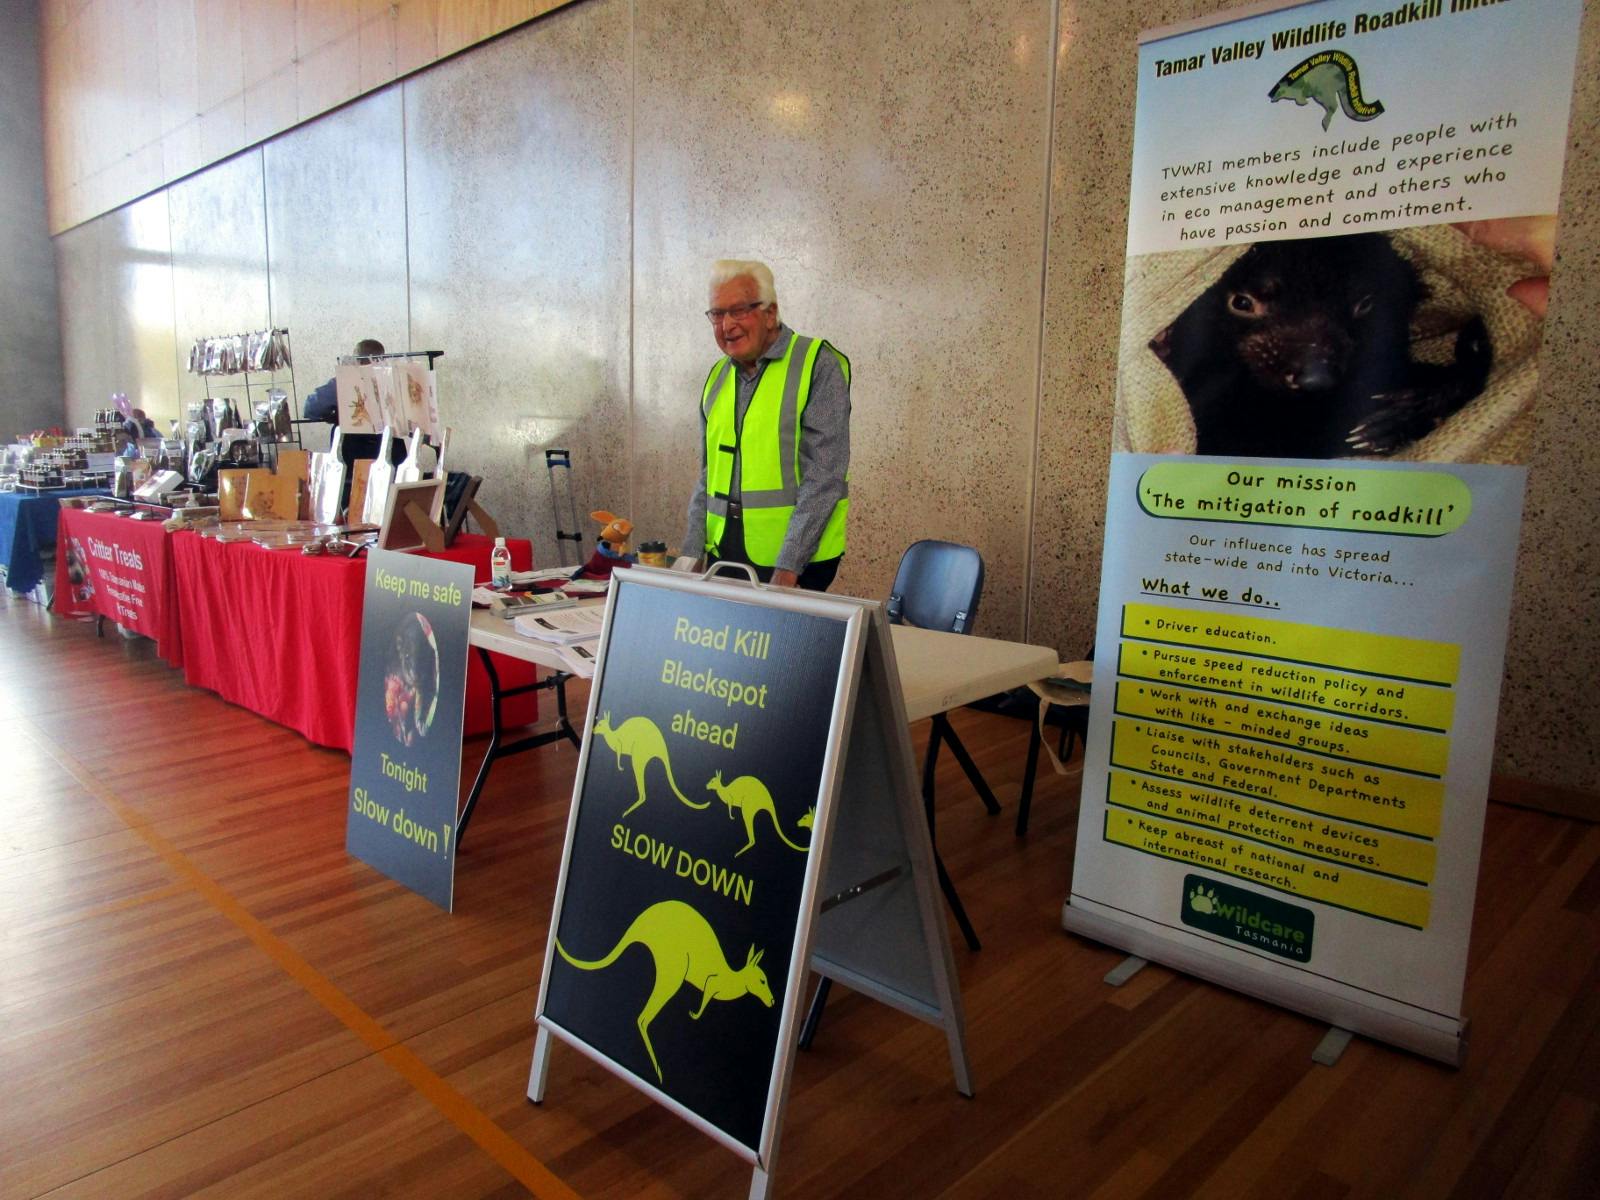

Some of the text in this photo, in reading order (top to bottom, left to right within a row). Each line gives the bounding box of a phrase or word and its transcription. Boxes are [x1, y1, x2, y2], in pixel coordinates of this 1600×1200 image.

[1155, 54, 1205, 77] Tamar
[1211, 40, 1265, 65] Valley
[1272, 20, 1346, 50] Wildlife
[1354, 0, 1442, 34] Roadkill
[1162, 112, 1517, 180] TVWRI members include people with
[1160, 143, 1513, 201] extensive knowledge and experience
[1162, 167, 1506, 222] in eco management and others who
[1180, 197, 1472, 241] have passion and commitment.
[1227, 471, 1356, 492] Our mission
[1198, 497, 1305, 518] mitigation
[1319, 501, 1339, 519] of
[88, 536, 144, 571] Critter Treats
[1164, 552, 1415, 587] state-wide and into Victoria...
[1189, 534, 1390, 563] Our influence has spread
[375, 567, 462, 607] Keep me safe
[1142, 577, 1280, 606] What we do..
[673, 616, 771, 660] Road Kill
[1156, 619, 1277, 644] Driver education.
[661, 659, 768, 708] Blackspot
[1154, 649, 1405, 699] Pursue speed reduction policy and
[1159, 667, 1408, 719] enforcement in wildlife corridors.
[671, 709, 738, 750] ahead
[1150, 688, 1369, 738] Work with and exchange ideas
[1155, 707, 1183, 719] with
[1191, 711, 1215, 725] like
[1241, 722, 1291, 740] minded
[1298, 734, 1350, 753] groups.
[380, 753, 427, 793] Tonight
[1146, 727, 1380, 785] Liaise with stakeholders such as
[1150, 759, 1278, 798] State and Federal.
[1152, 744, 1406, 810] Councils, Government Departments
[353, 787, 390, 826] Slow
[393, 808, 438, 854] down
[1141, 781, 1379, 848] Assess wildlife deterrent devices
[1146, 799, 1380, 866] and animal protection measures.
[610, 823, 754, 906] SLOW DOWN
[1138, 819, 1340, 883] Keep abreast of national and
[1143, 838, 1297, 890] international research.
[1234, 925, 1304, 955] Tasmania
